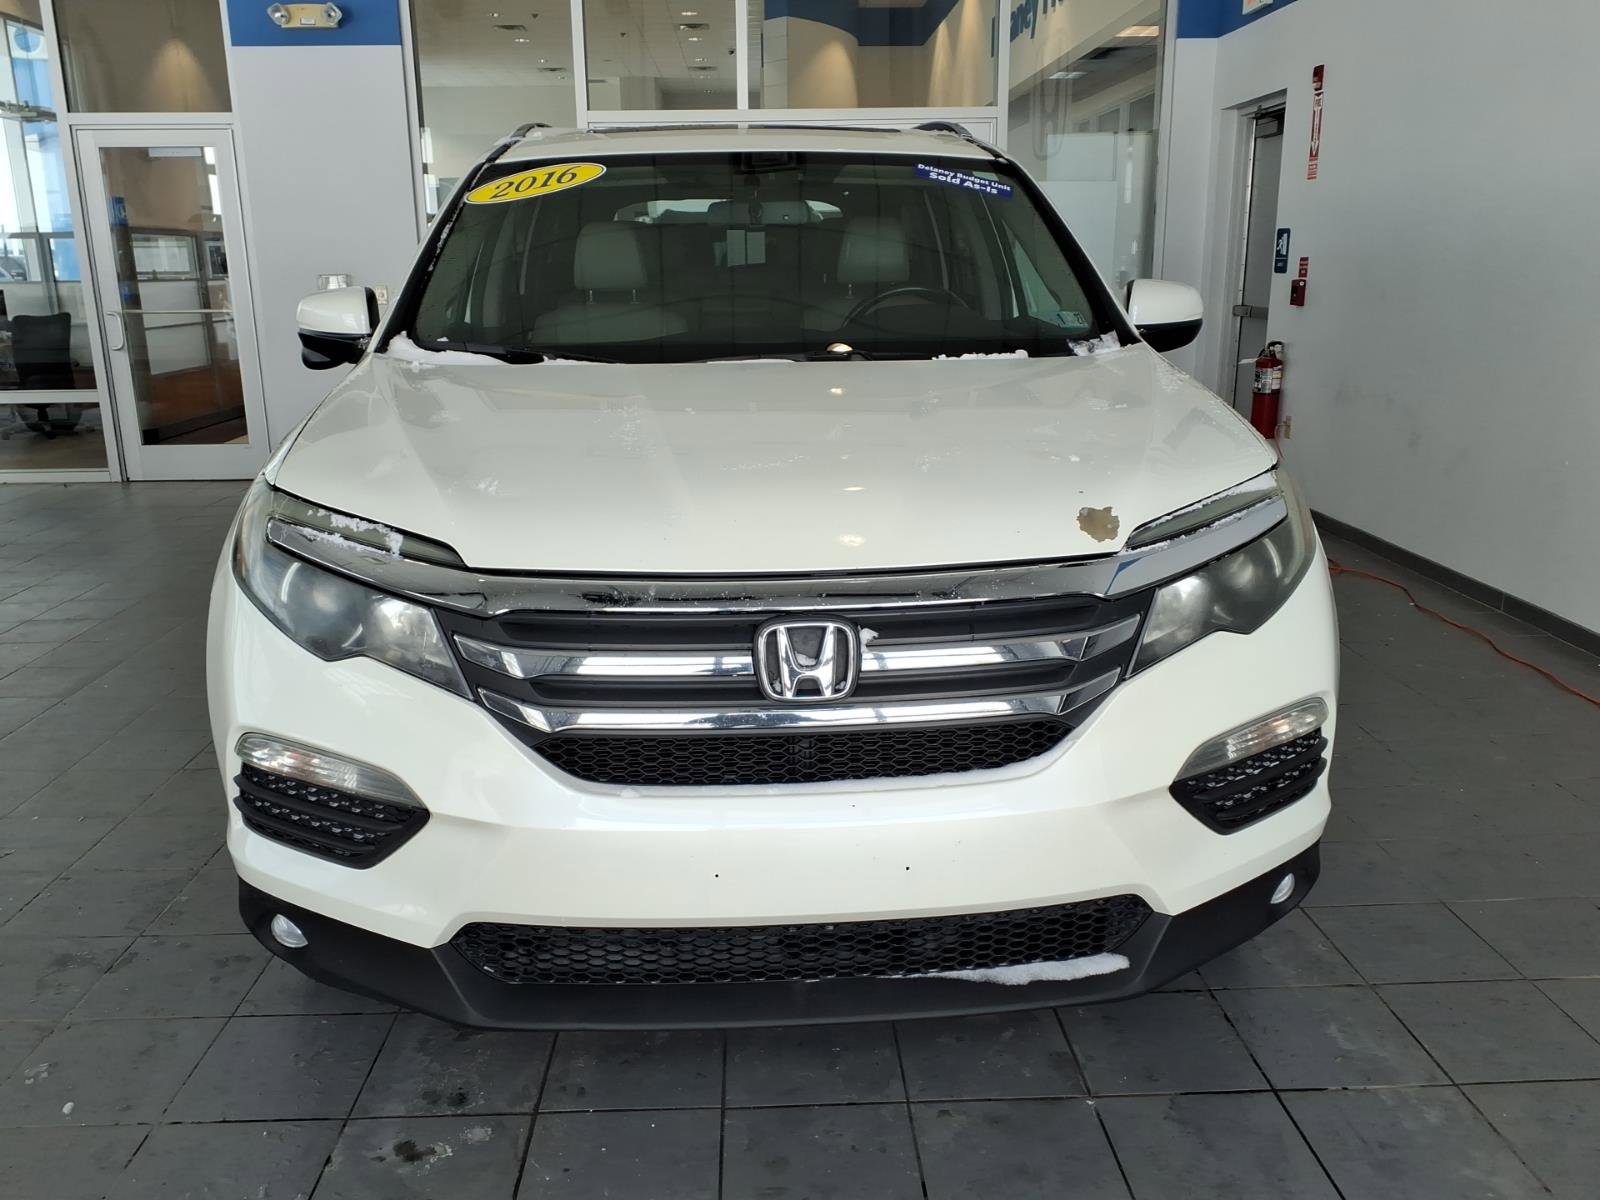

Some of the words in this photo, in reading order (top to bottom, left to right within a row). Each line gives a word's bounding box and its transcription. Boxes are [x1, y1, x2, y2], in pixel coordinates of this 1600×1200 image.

[488, 165, 581, 200] 2016
[917, 163, 955, 177] Delaney
[956, 172, 990, 186] Budget
[991, 181, 1012, 192] Unit
[929, 172, 960, 185] Sold
